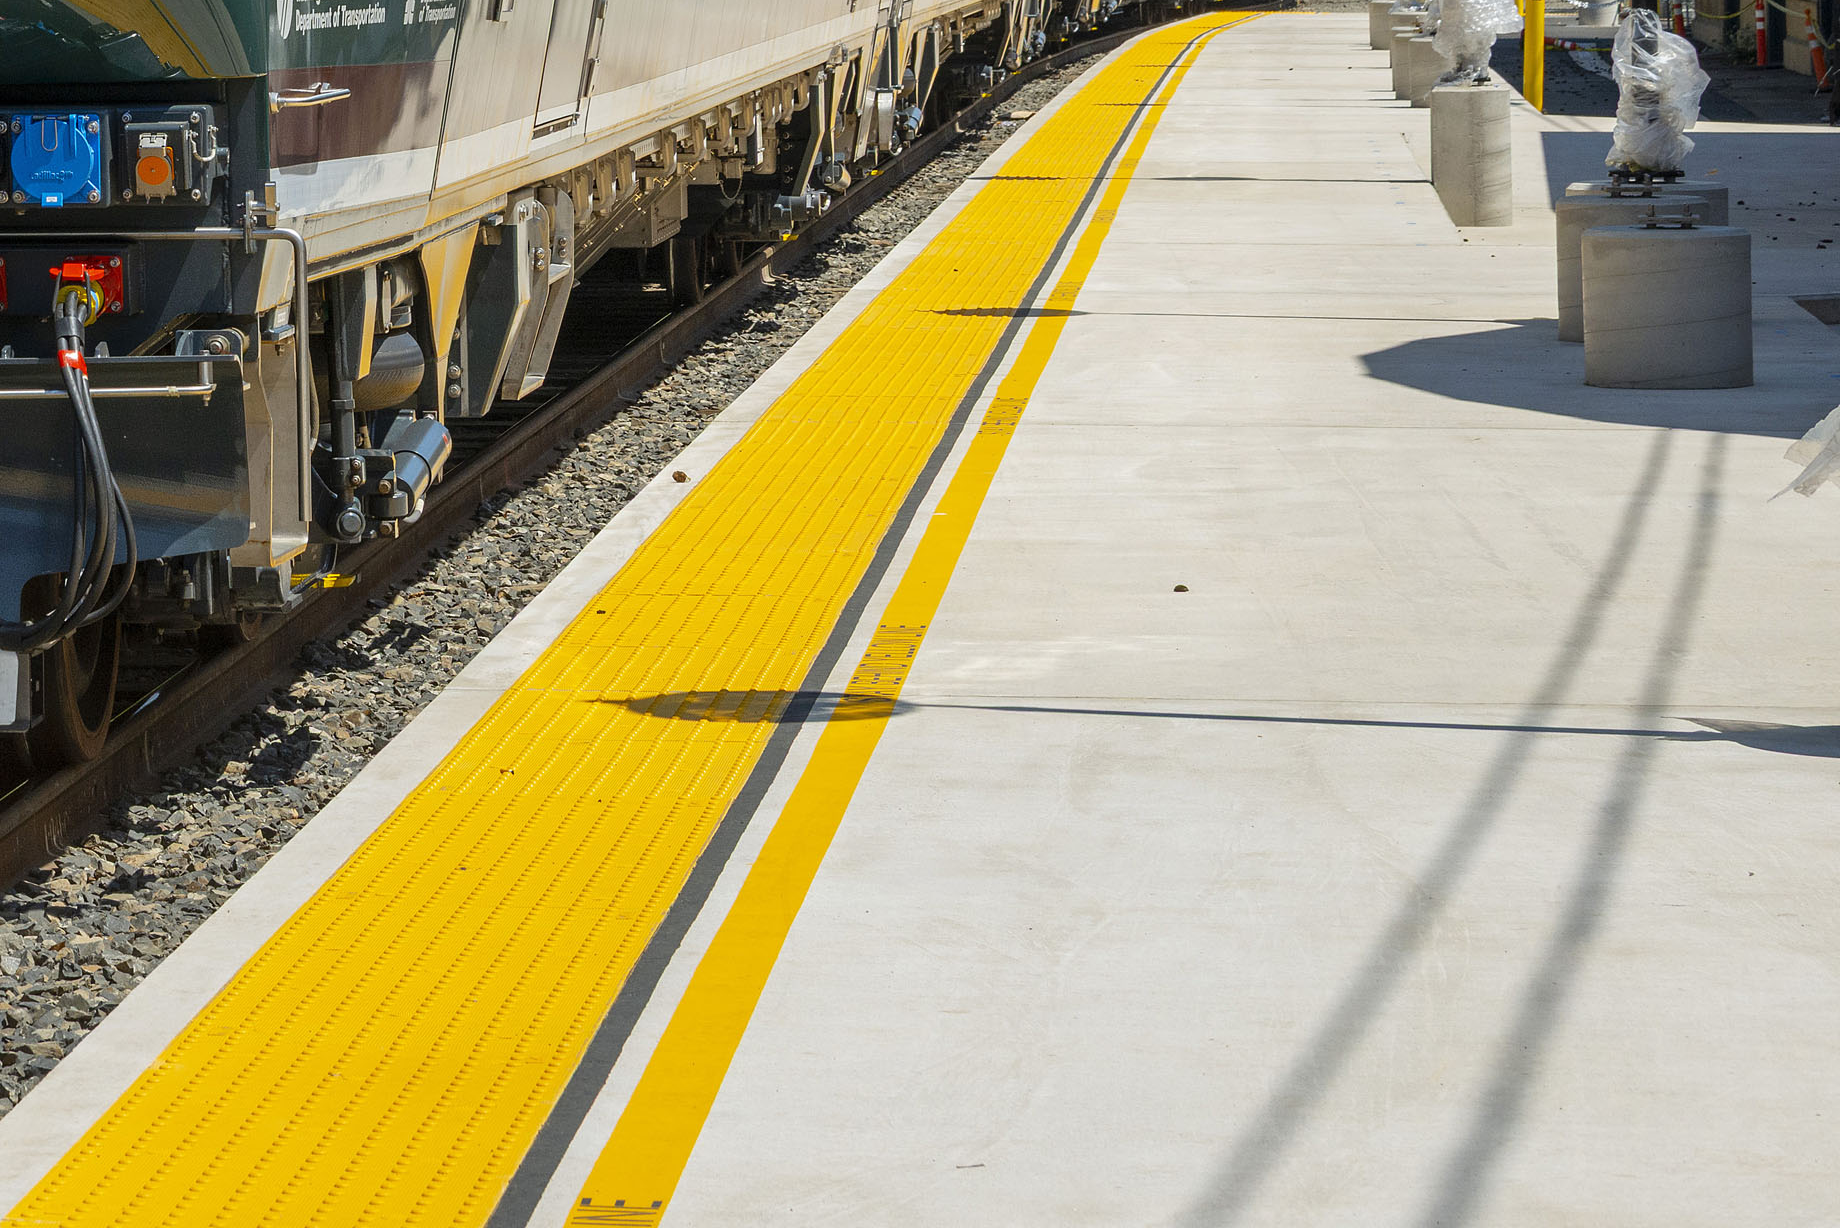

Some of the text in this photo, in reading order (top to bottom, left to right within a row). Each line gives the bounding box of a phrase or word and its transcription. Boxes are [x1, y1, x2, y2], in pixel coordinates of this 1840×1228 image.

[295, 2, 386, 35] Department of Transportation
[418, 4, 456, 24] of Transportation
